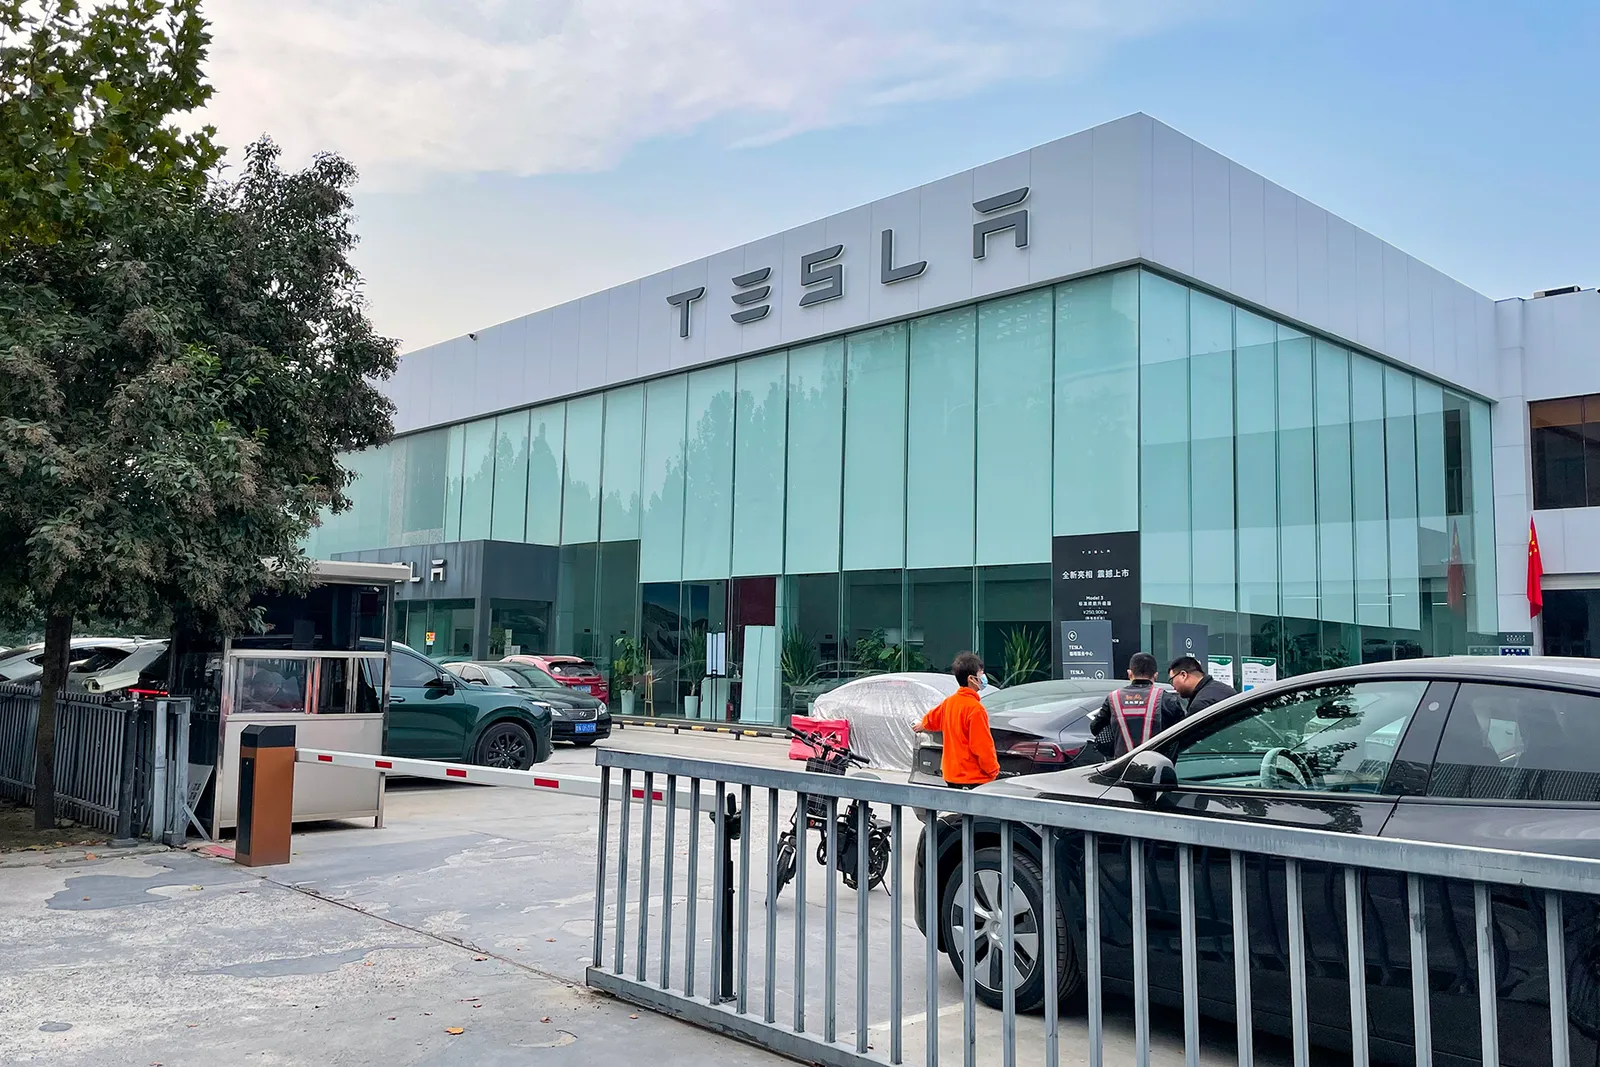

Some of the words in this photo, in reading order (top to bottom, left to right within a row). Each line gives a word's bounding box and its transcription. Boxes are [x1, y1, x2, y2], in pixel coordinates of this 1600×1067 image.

[666, 186, 1030, 338] TESLA
[1062, 570, 1093, 580] 全新亮相
[1097, 568, 1130, 579] 震撼上市
